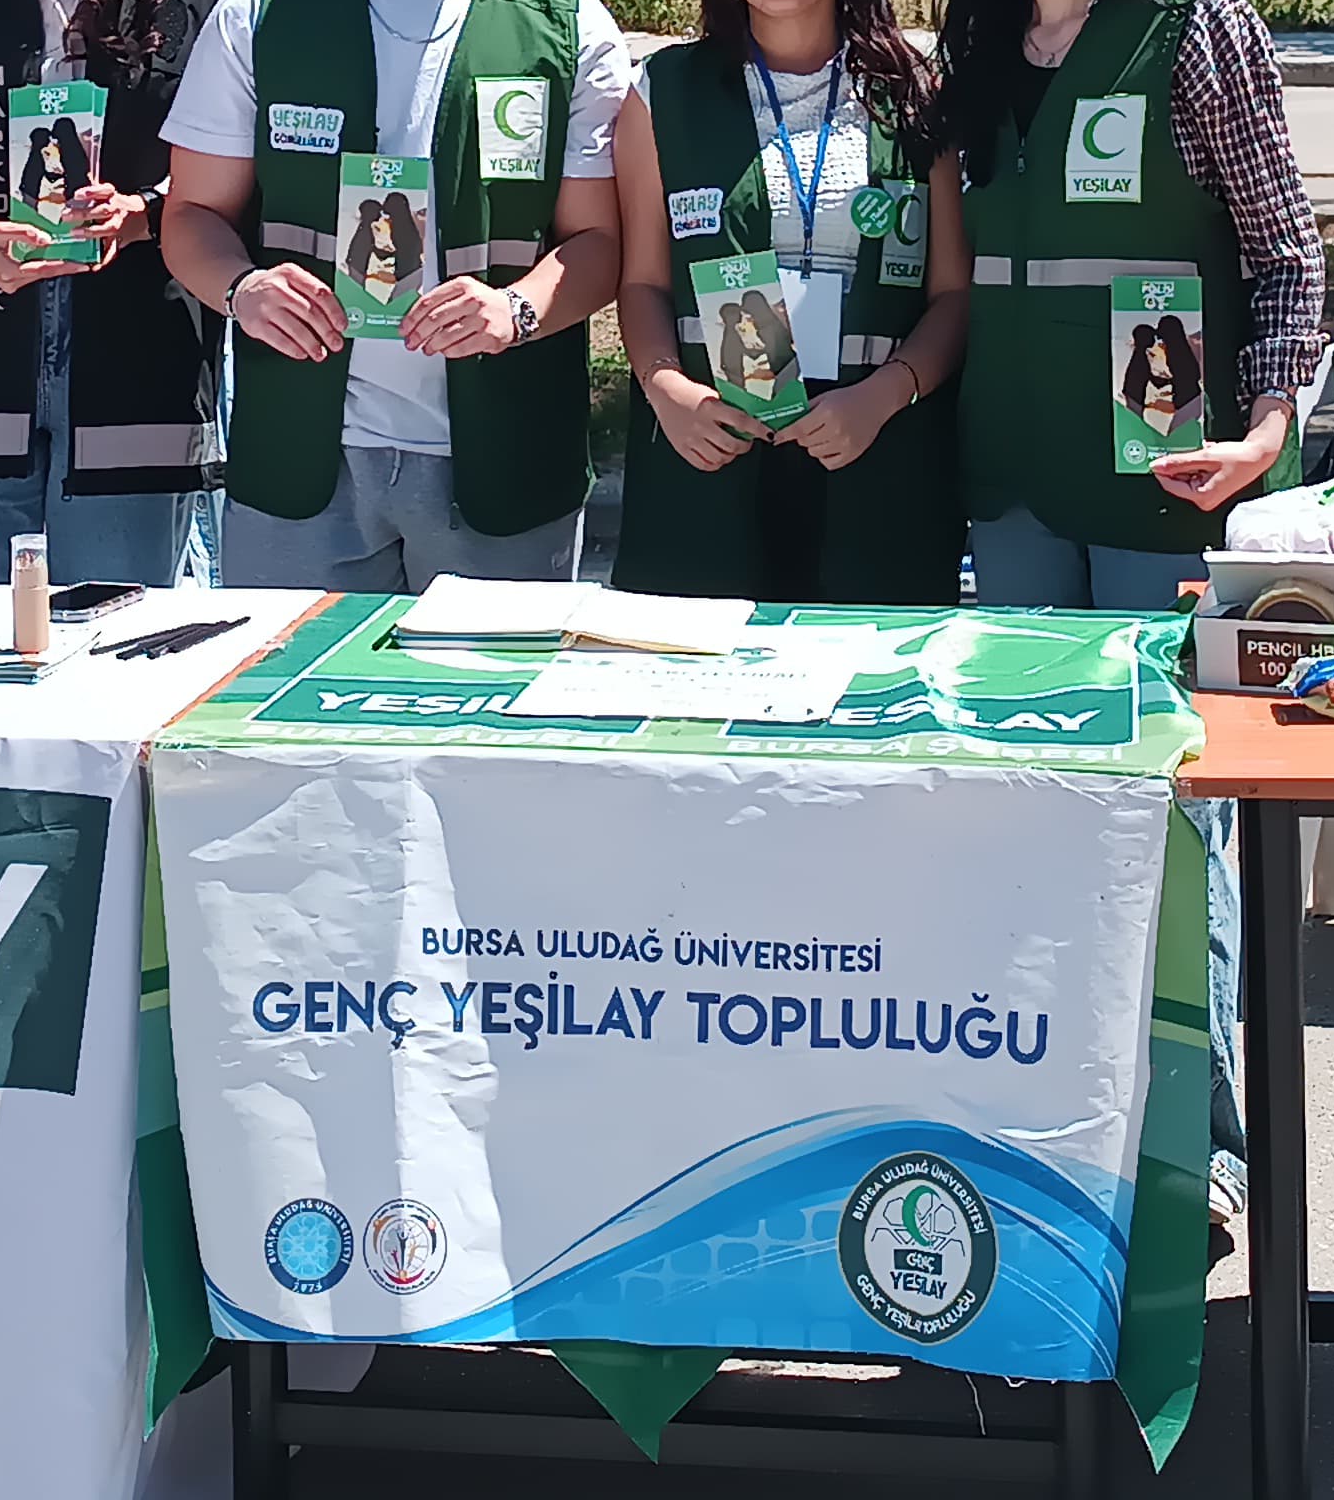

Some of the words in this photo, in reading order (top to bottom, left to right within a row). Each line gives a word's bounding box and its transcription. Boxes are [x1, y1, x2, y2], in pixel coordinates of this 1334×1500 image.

[1259, 661, 1286, 677] 100
[422, 926, 525, 958] BURSA
[536, 924, 663, 966] ULUDAĞ
[674, 930, 883, 973] ÜNİVERSİTESİ
[252, 979, 418, 1049] GENÇ
[441, 970, 666, 1050] YEŞİLAY
[687, 990, 1050, 1065] TOPLULUĞU
[851, 1181, 884, 1221] BURSA
[880, 1159, 930, 1185] ULUDAĞ
[930, 1163, 989, 1235] ÜNİVERSİTESİ
[856, 1273, 886, 1311] GENÇ
